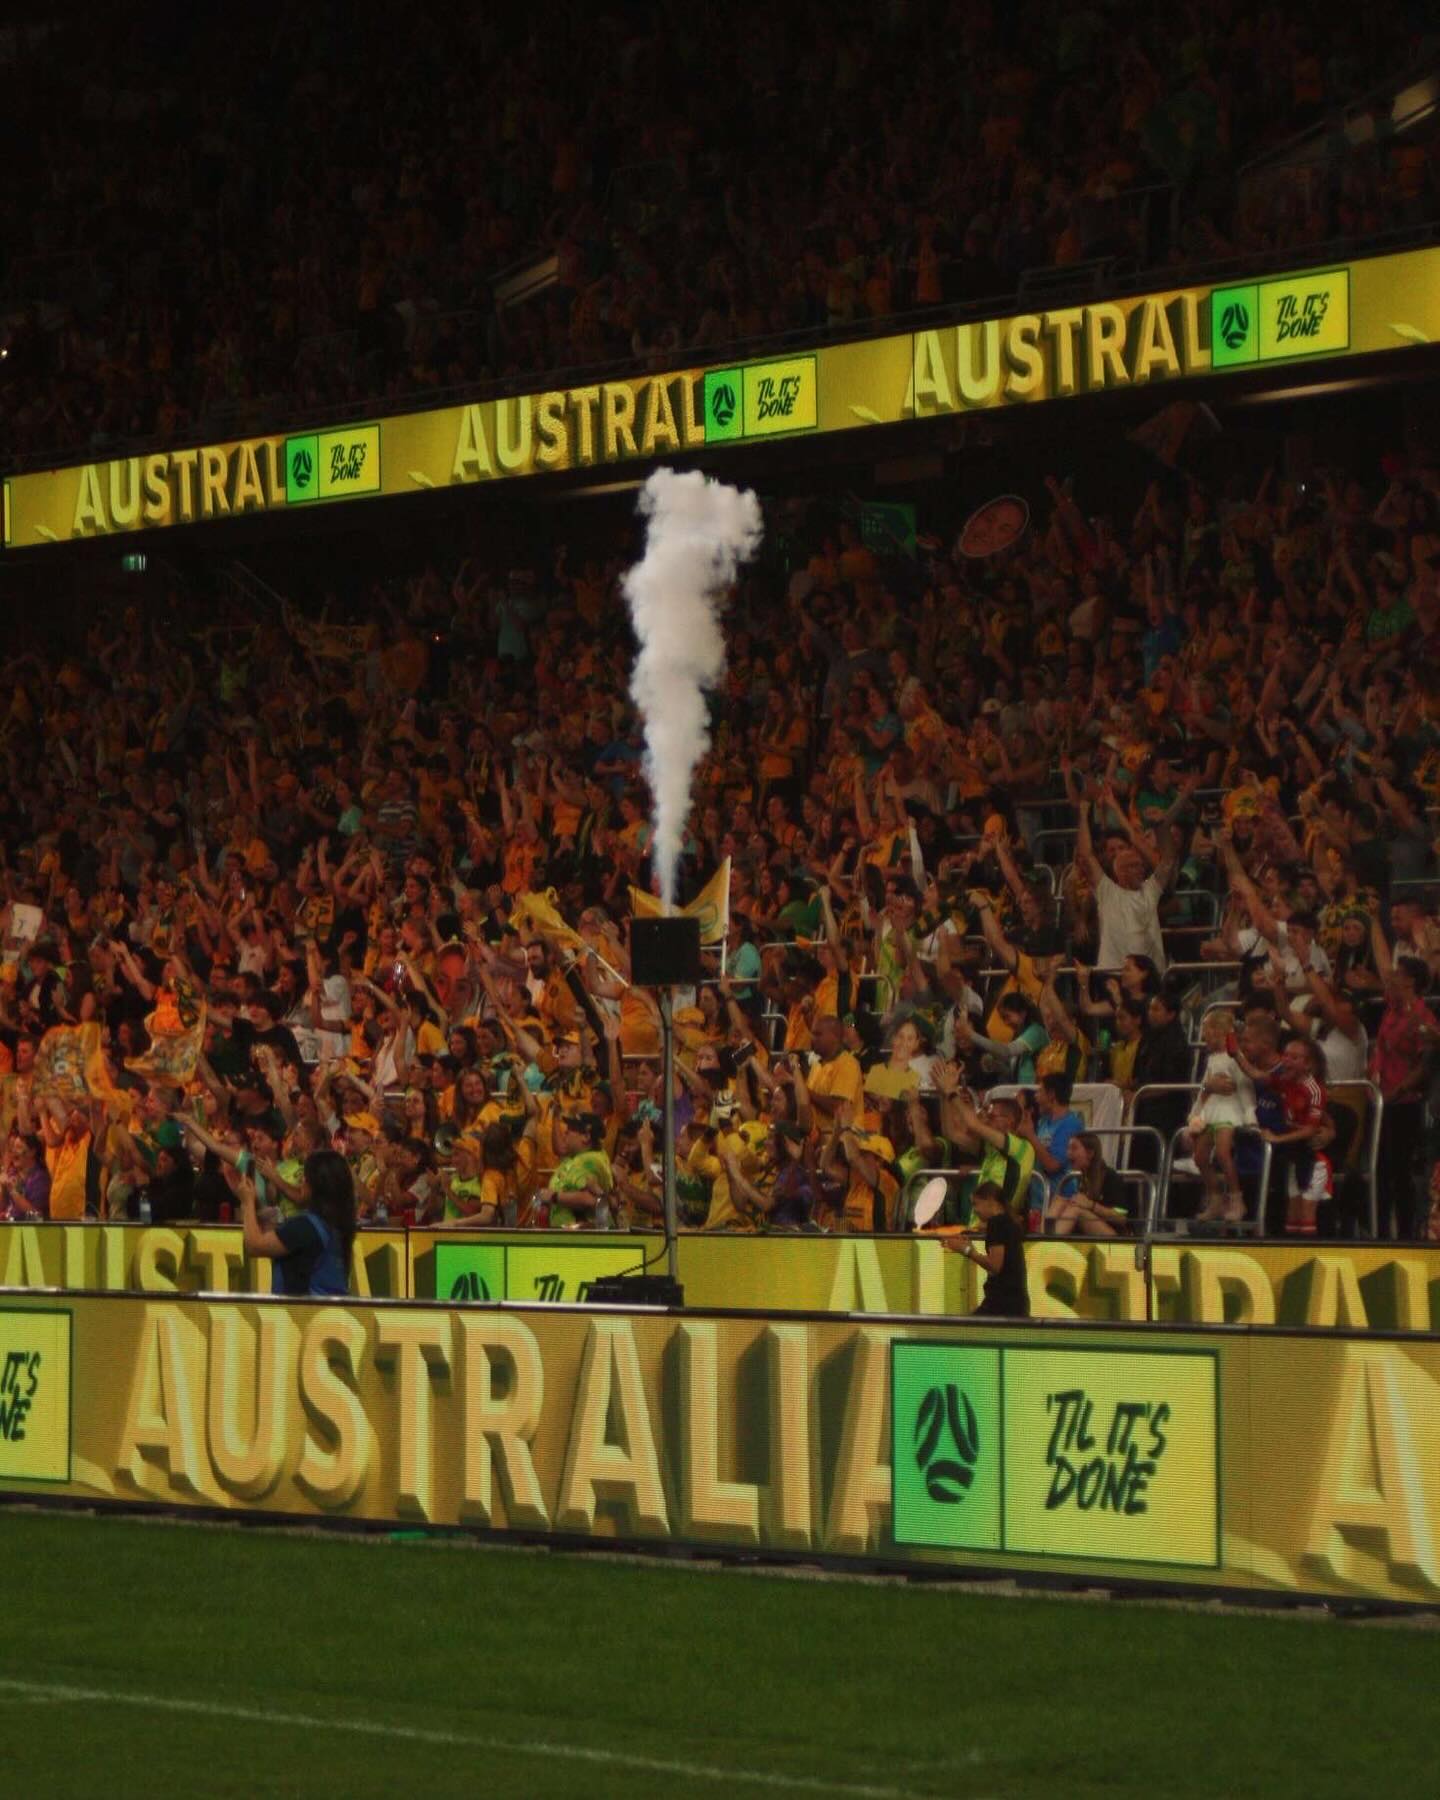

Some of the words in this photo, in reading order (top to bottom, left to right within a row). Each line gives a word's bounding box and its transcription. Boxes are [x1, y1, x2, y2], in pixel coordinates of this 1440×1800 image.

[1303, 291, 1330, 316] IT'S
[1277, 311, 1323, 343] DONE
[903, 291, 1210, 410] AUSTRAL
[758, 392, 795, 421] DONE
[779, 375, 800, 397] IT'S
[452, 374, 704, 481] AUSTRAL
[73, 440, 286, 532] AUSTRAL
[330, 458, 362, 483] DONE
[0, 1351, 40, 1395] IT'S
[1046, 1390, 1095, 1465] 'TIL
[1107, 1402, 1170, 1459] IT'S
[1046, 1441, 1155, 1514] DONE
